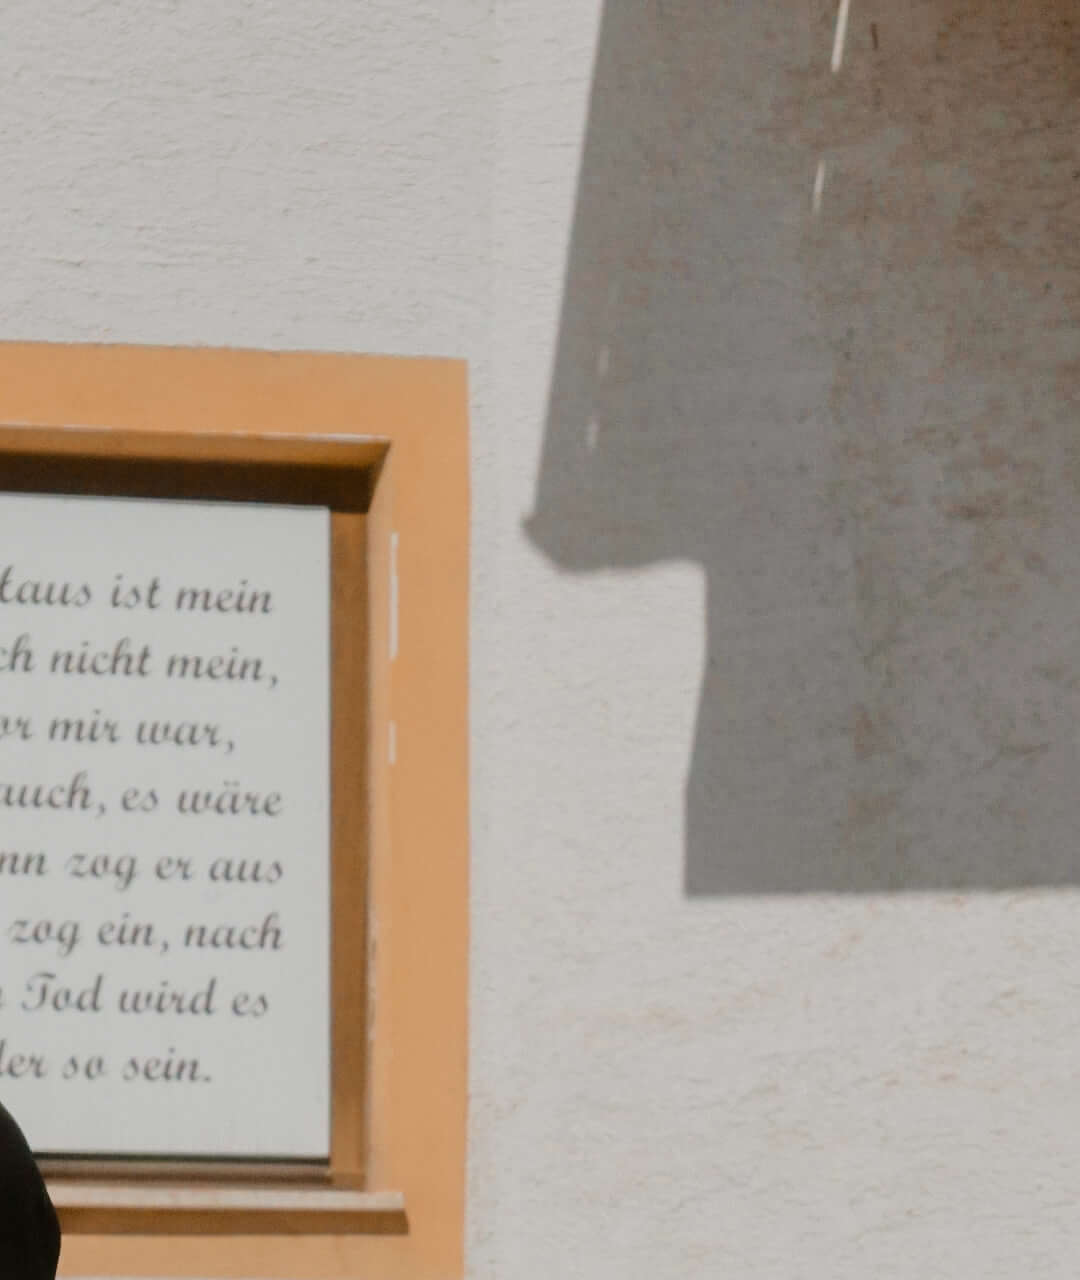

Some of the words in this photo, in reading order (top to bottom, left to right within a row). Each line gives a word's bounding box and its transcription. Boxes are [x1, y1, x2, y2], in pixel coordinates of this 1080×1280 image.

[111, 575, 160, 610] ist
[176, 580, 272, 614] mein
[51, 638, 150, 677] nicht
[167, 648, 277, 686] mein,
[49, 710, 117, 743] mir
[137, 723, 234, 752] war,
[122, 790, 158, 811] es
[178, 782, 280, 816] wäre
[68, 854, 136, 890] zog
[155, 856, 192, 882] er
[209, 860, 283, 883] aus
[10, 920, 79, 956] zog
[98, 913, 168, 952] ein,
[184, 913, 281, 950] nach
[22, 972, 103, 1012] Tod
[119, 978, 216, 1015] wird
[232, 995, 268, 1016] es
[63, 1057, 103, 1080] so
[124, 1048, 210, 1082] sein.
